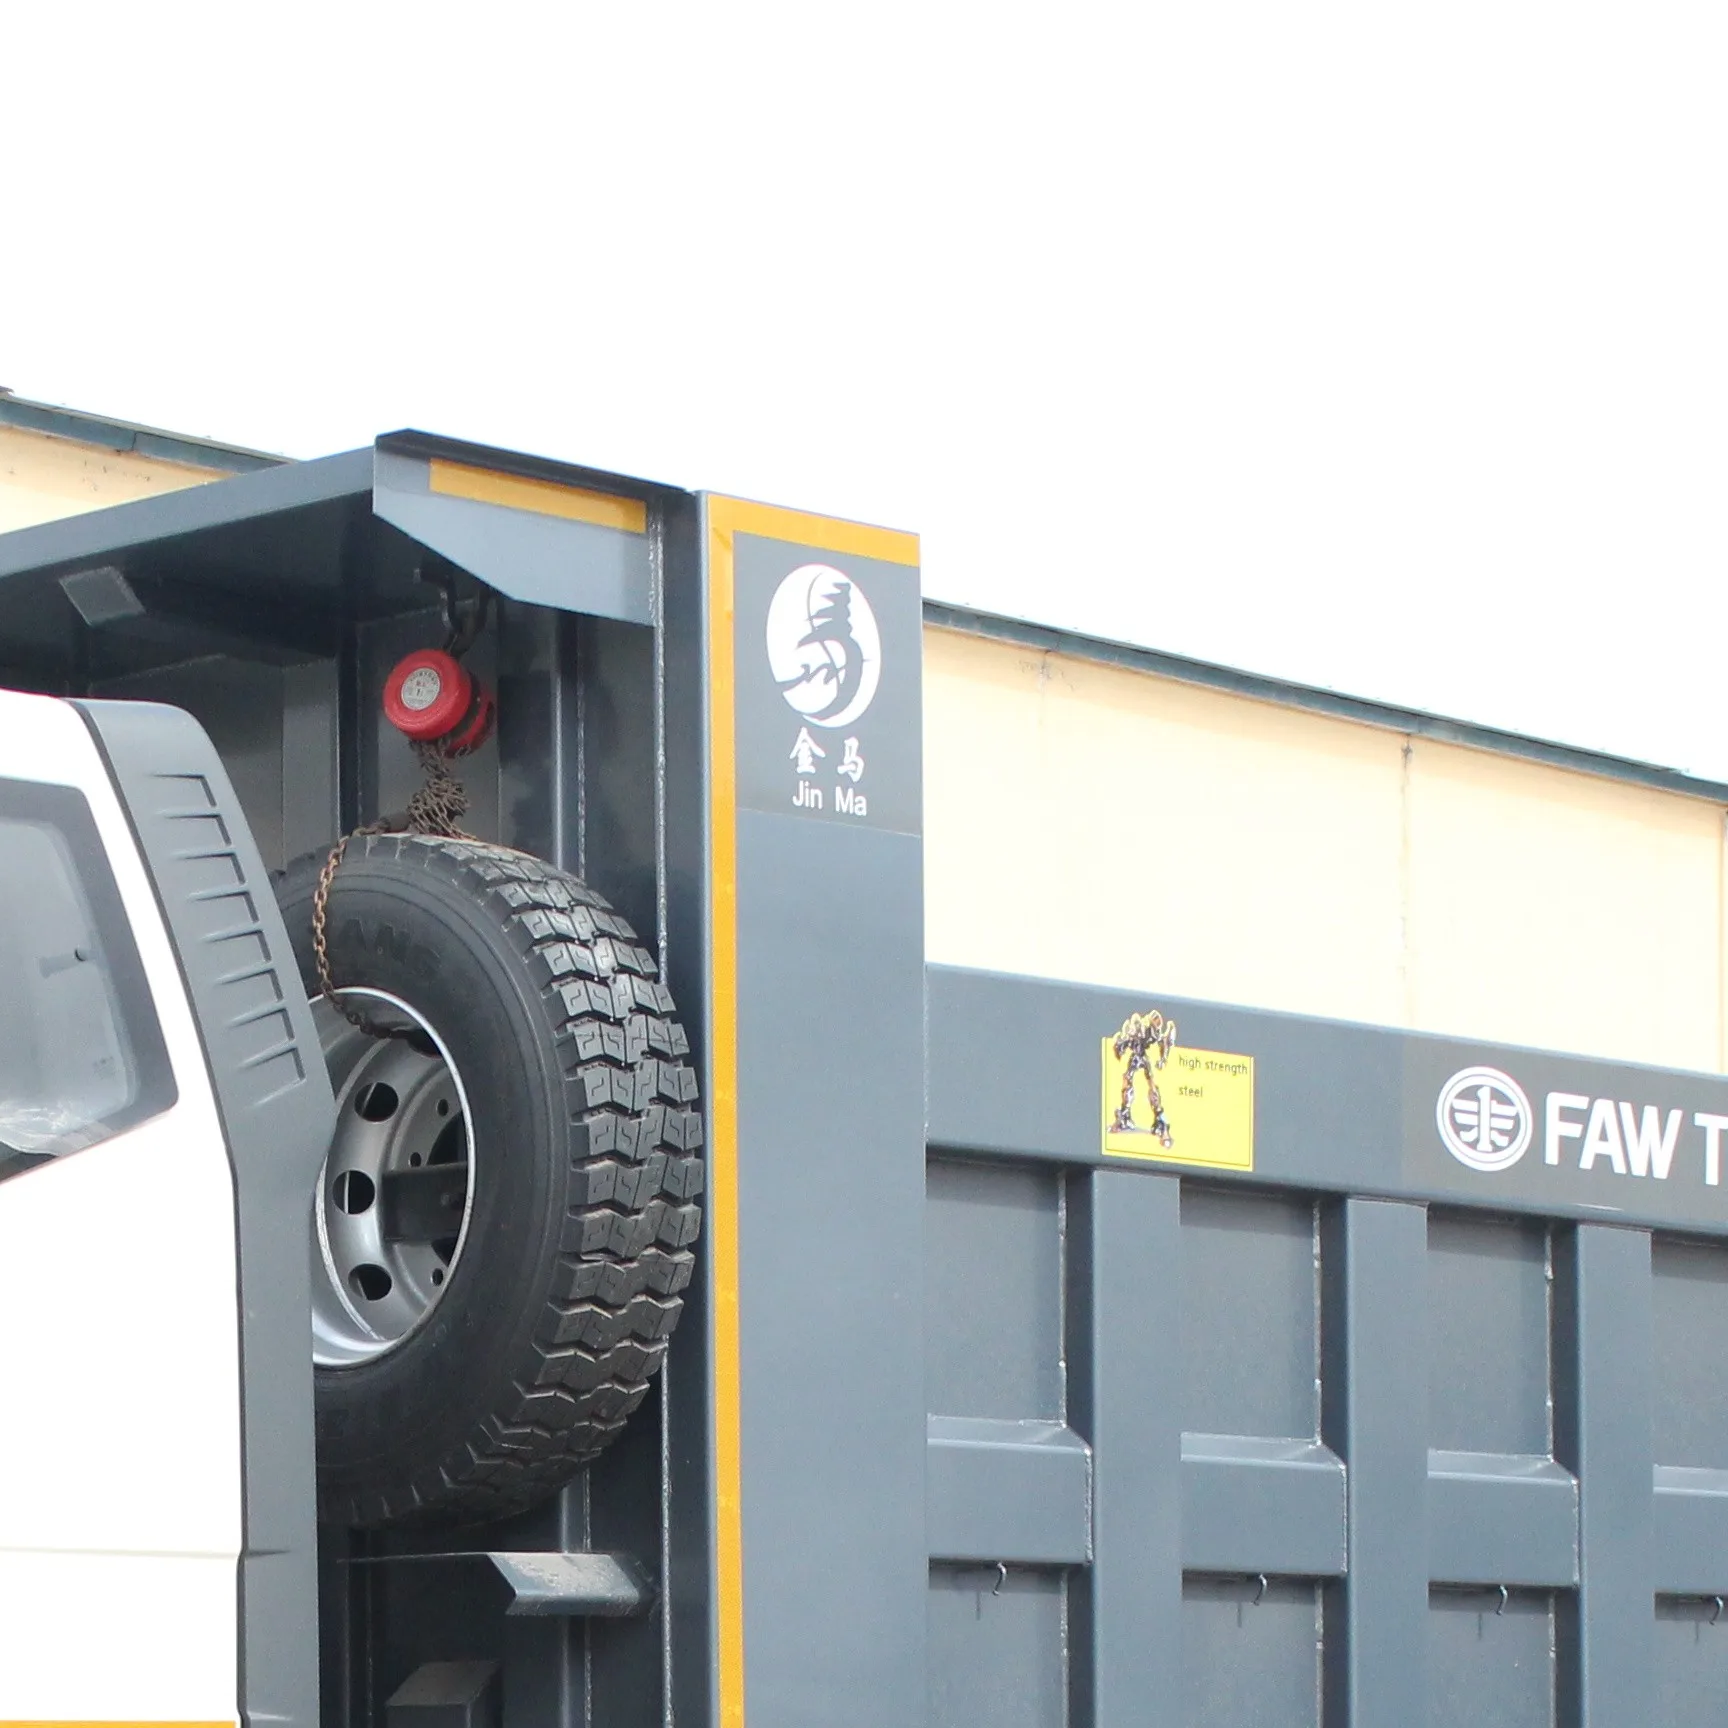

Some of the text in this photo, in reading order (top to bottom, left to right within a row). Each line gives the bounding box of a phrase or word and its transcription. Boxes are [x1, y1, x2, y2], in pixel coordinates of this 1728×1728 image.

[789, 727, 866, 782] 金马
[792, 780, 868, 816] Jin Ma
[1179, 1054, 1248, 1077] high strength
[1178, 1086, 1204, 1098] steel
[1545, 1091, 1728, 1186] FAW T
